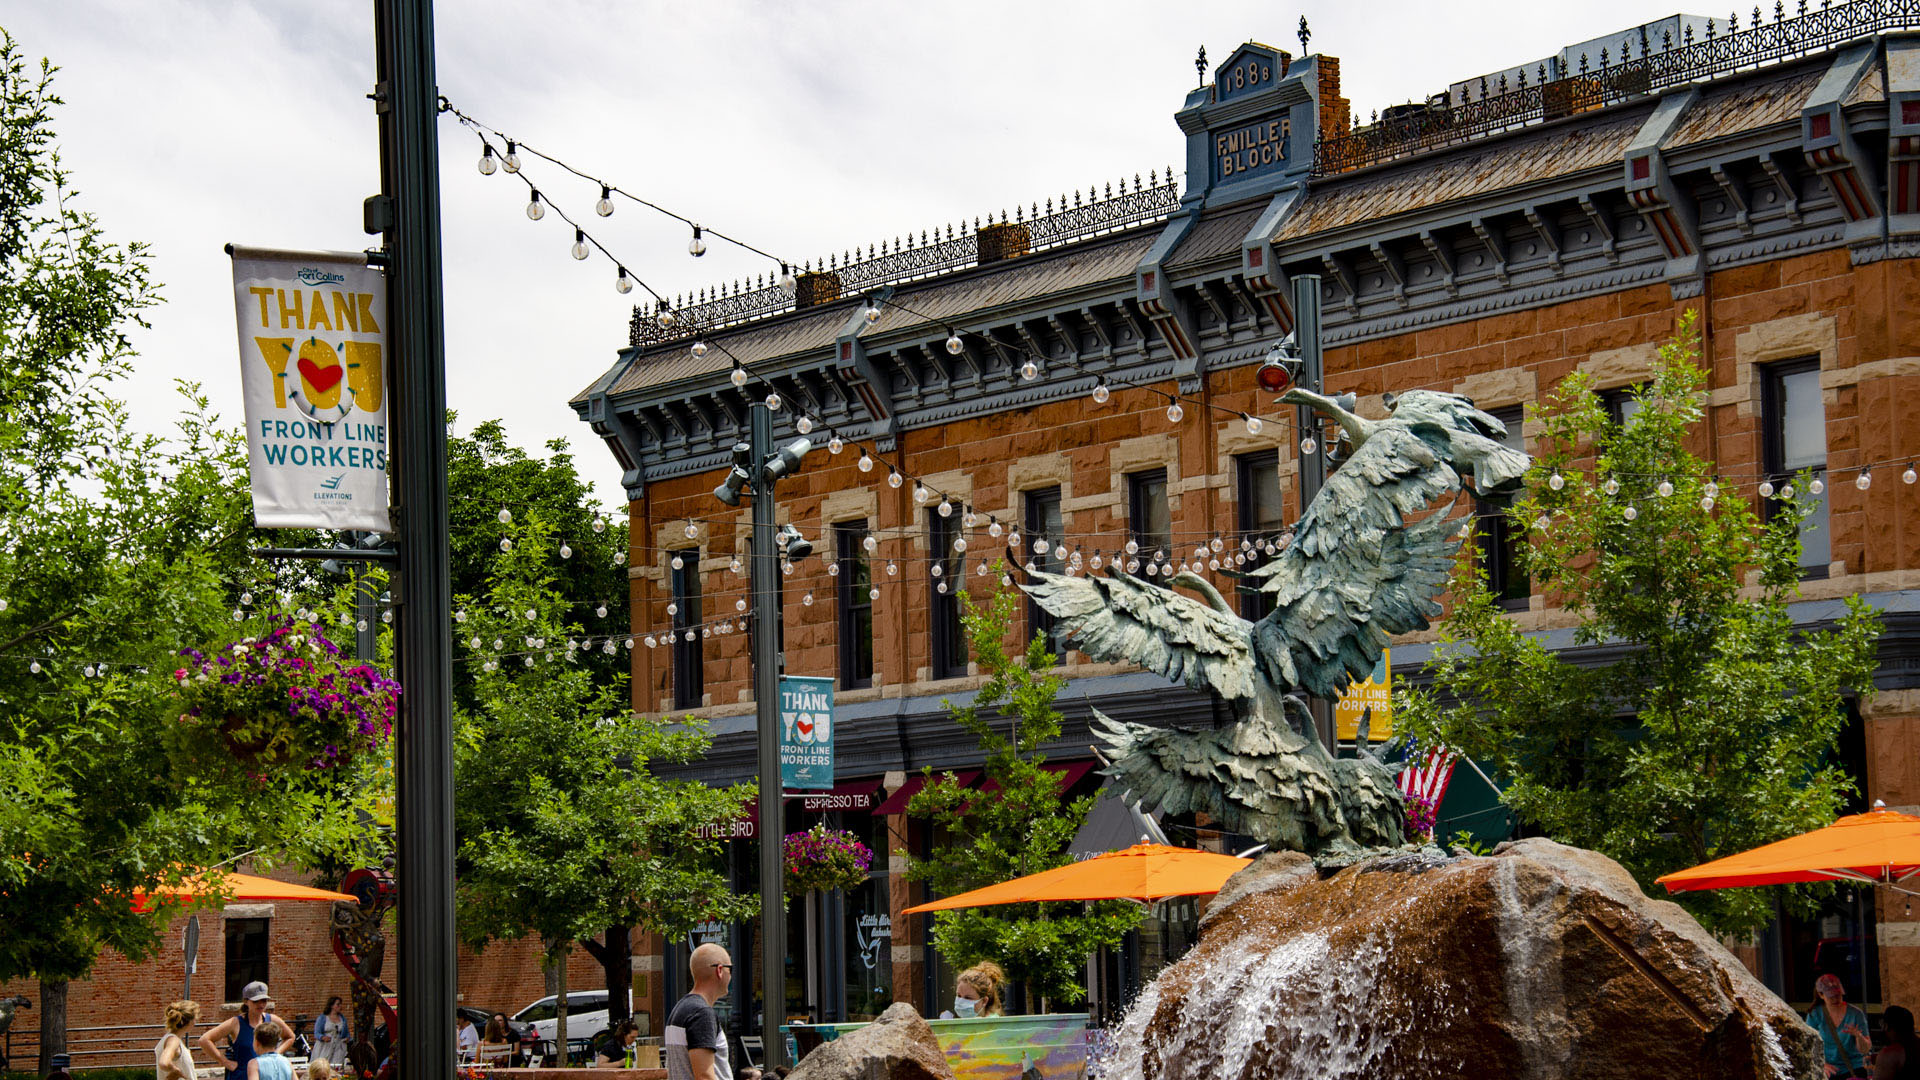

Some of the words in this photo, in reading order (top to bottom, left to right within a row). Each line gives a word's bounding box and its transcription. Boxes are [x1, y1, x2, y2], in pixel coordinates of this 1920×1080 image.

[1226, 62, 1270, 92] 1888
[1223, 141, 1285, 176] BLOCK
[298, 270, 315, 280] Fort
[316, 271, 345, 282] Collins
[250, 286, 381, 334] THANK
[254, 336, 382, 413] YOU
[261, 419, 336, 441] FRONT
[344, 422, 385, 444] LINE
[262, 443, 386, 471] WORKERS
[782, 692, 830, 711] THANK
[1366, 689, 1388, 700] LINE
[781, 711, 831, 743] YOU
[780, 745, 809, 754] FRONT
[811, 746, 831, 755] LINE
[780, 754, 831, 766] WORKERS
[853, 794, 870, 807] TEA
[730, 821, 754, 837] BIRD
